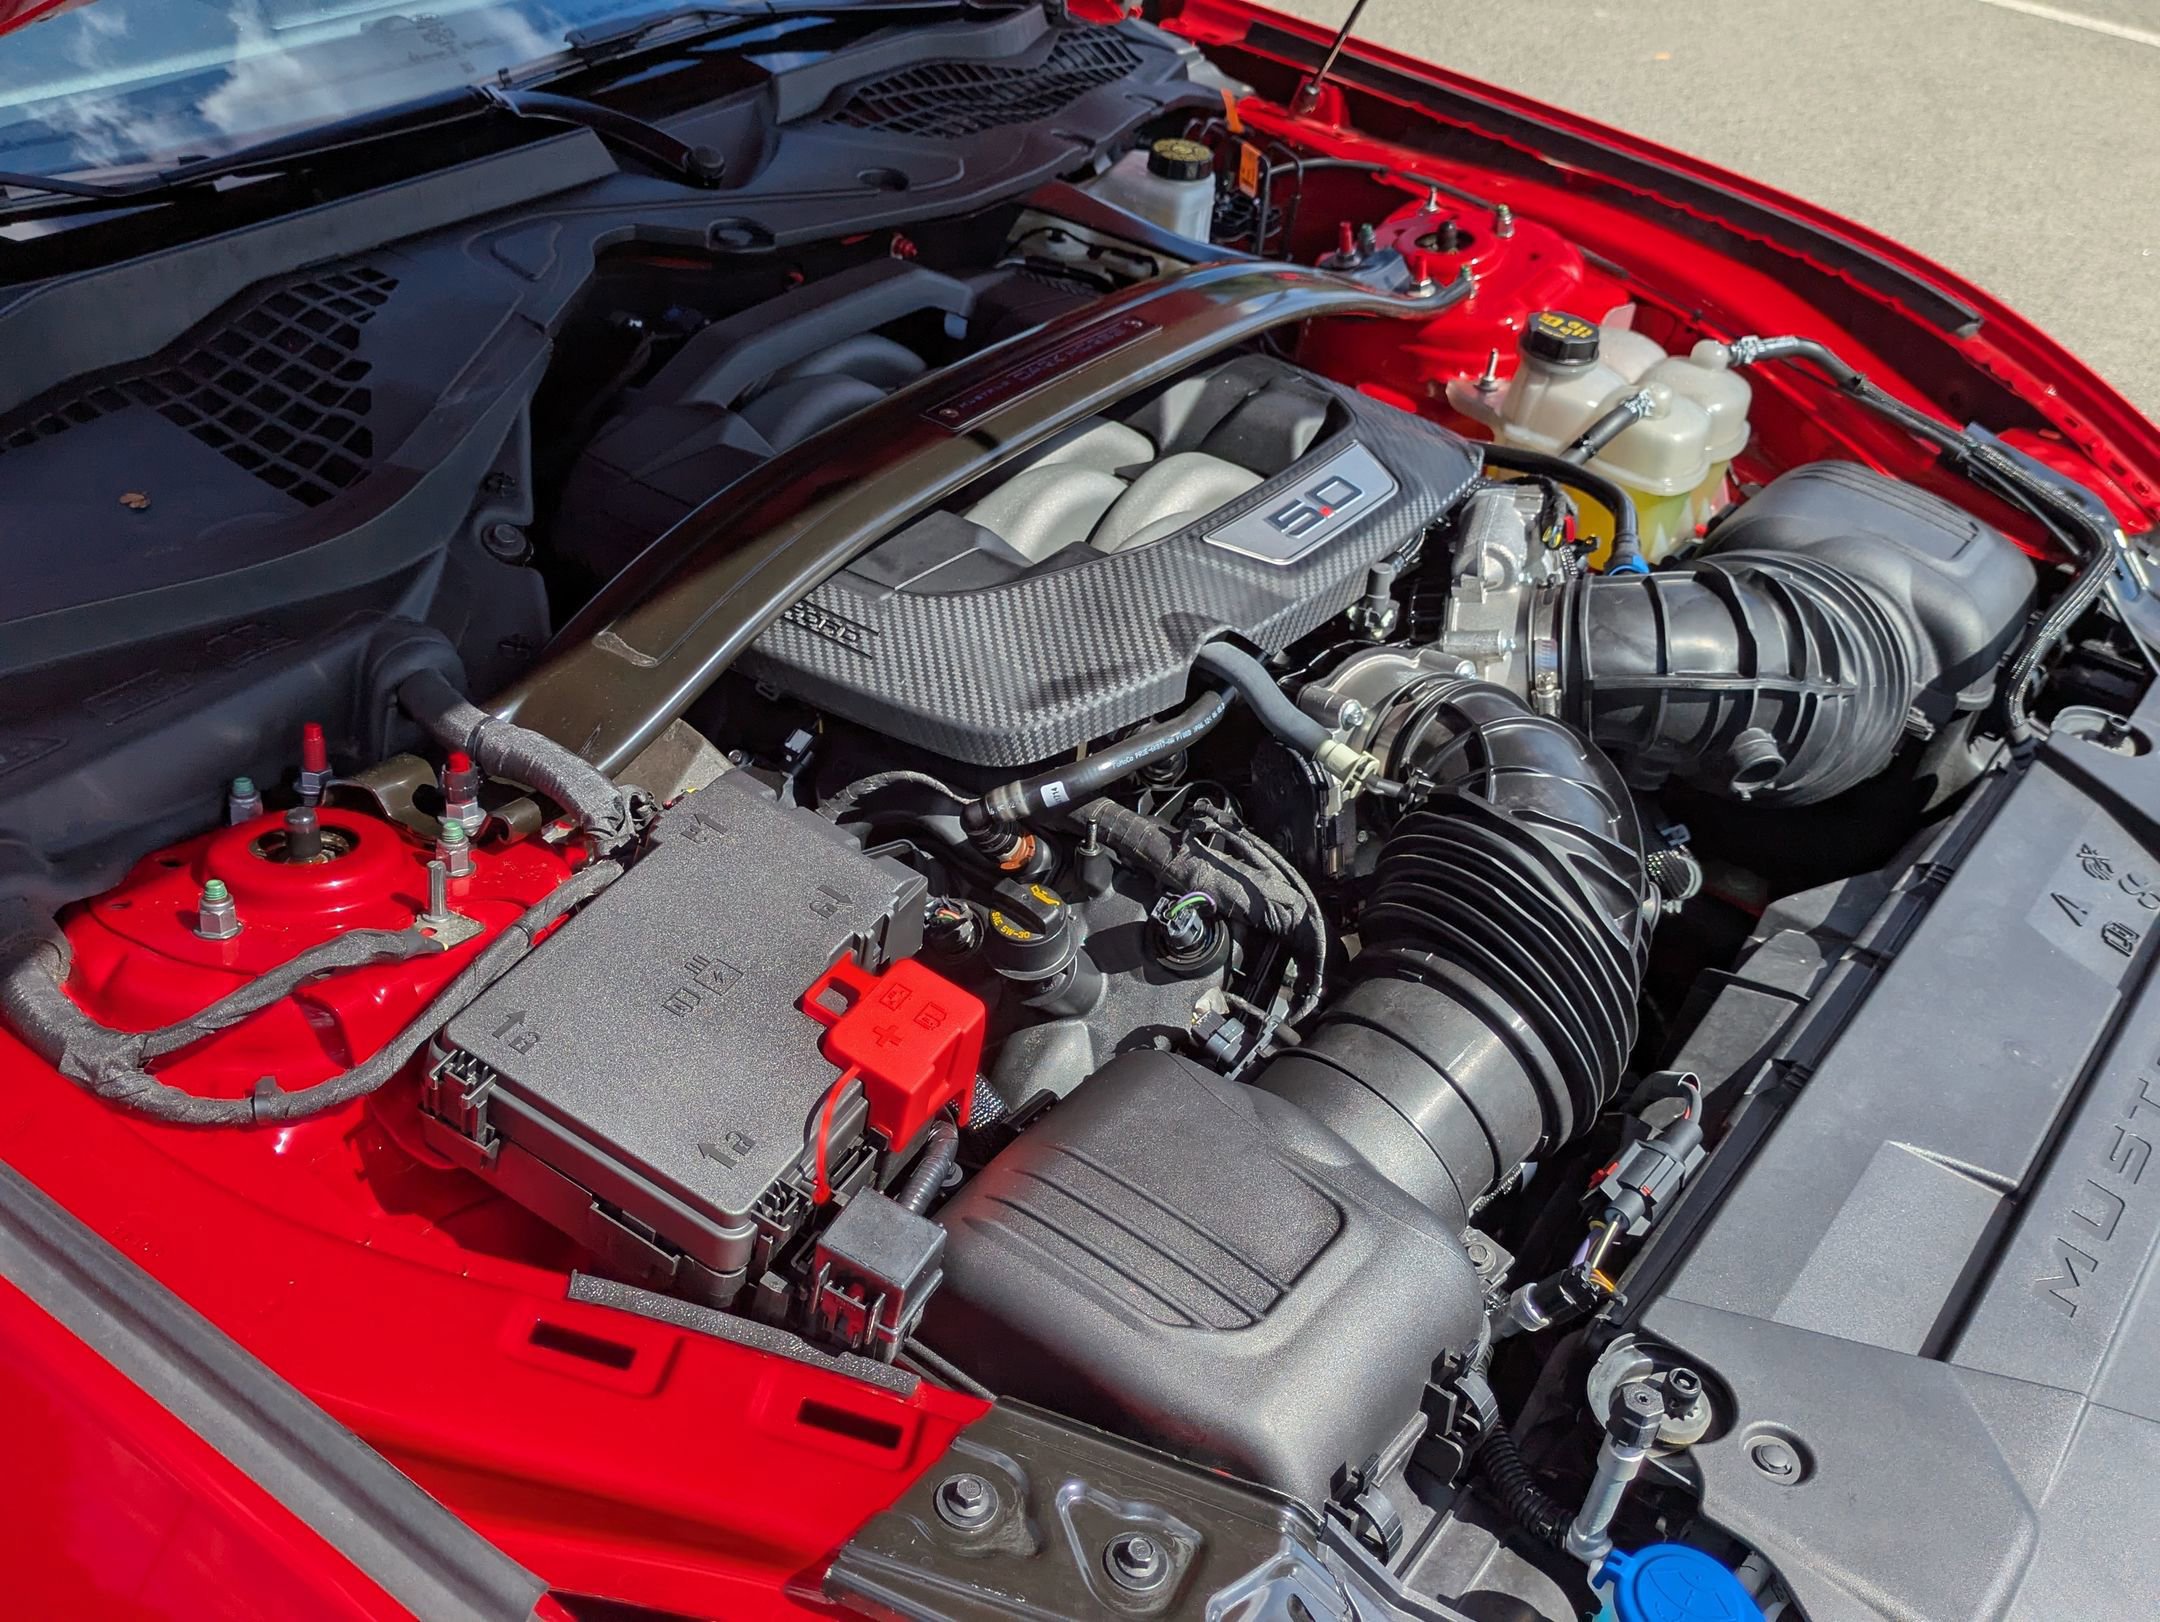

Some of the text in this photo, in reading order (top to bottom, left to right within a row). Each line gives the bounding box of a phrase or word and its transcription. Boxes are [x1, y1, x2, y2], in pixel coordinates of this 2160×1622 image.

[1264, 476, 1365, 538] 5.0
[991, 911, 1032, 939] SAE 5W-30
[2033, 1054, 2160, 1319] MUST
